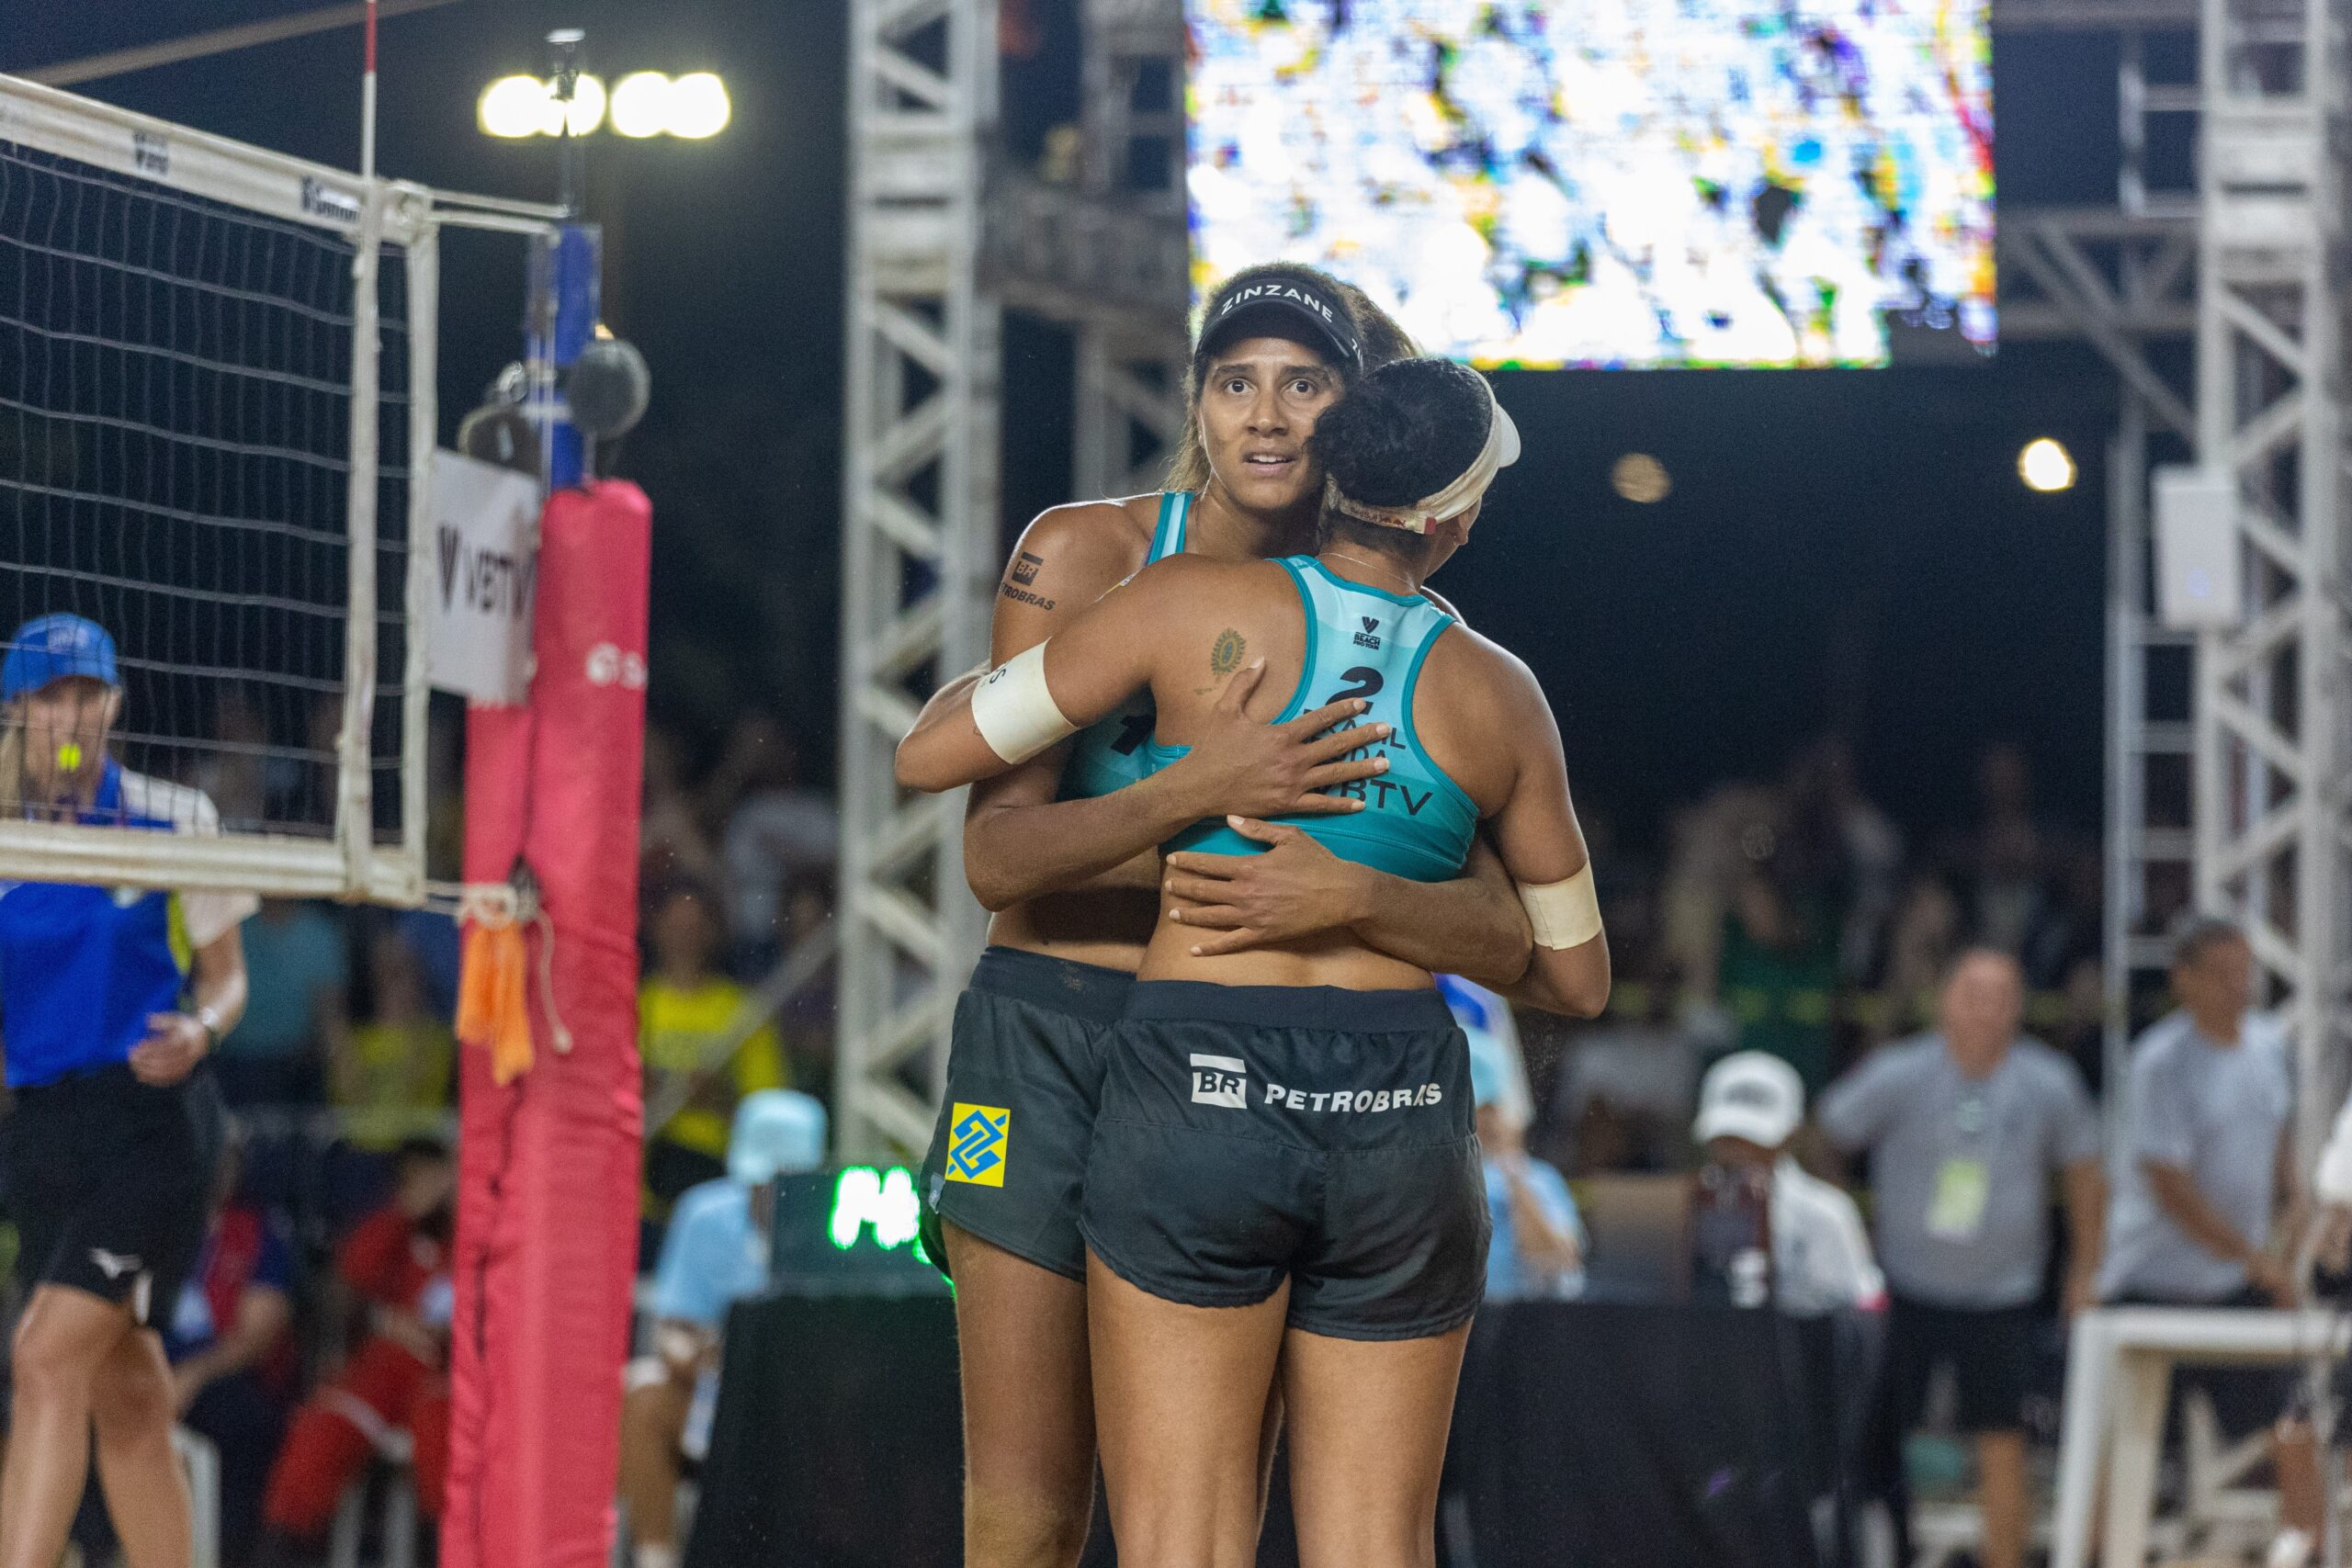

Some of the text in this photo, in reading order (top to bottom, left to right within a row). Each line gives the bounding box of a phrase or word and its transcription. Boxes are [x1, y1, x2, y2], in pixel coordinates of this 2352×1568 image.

[1221, 285, 1332, 322] ZINZANE
[1002, 582, 1056, 610] TROBRAS
[1354, 633, 1380, 647] BEACH
[1325, 667, 1385, 715] 2
[1325, 778, 1433, 816] BTV
[1198, 1072, 1442, 1113] BR PETROBRAS
